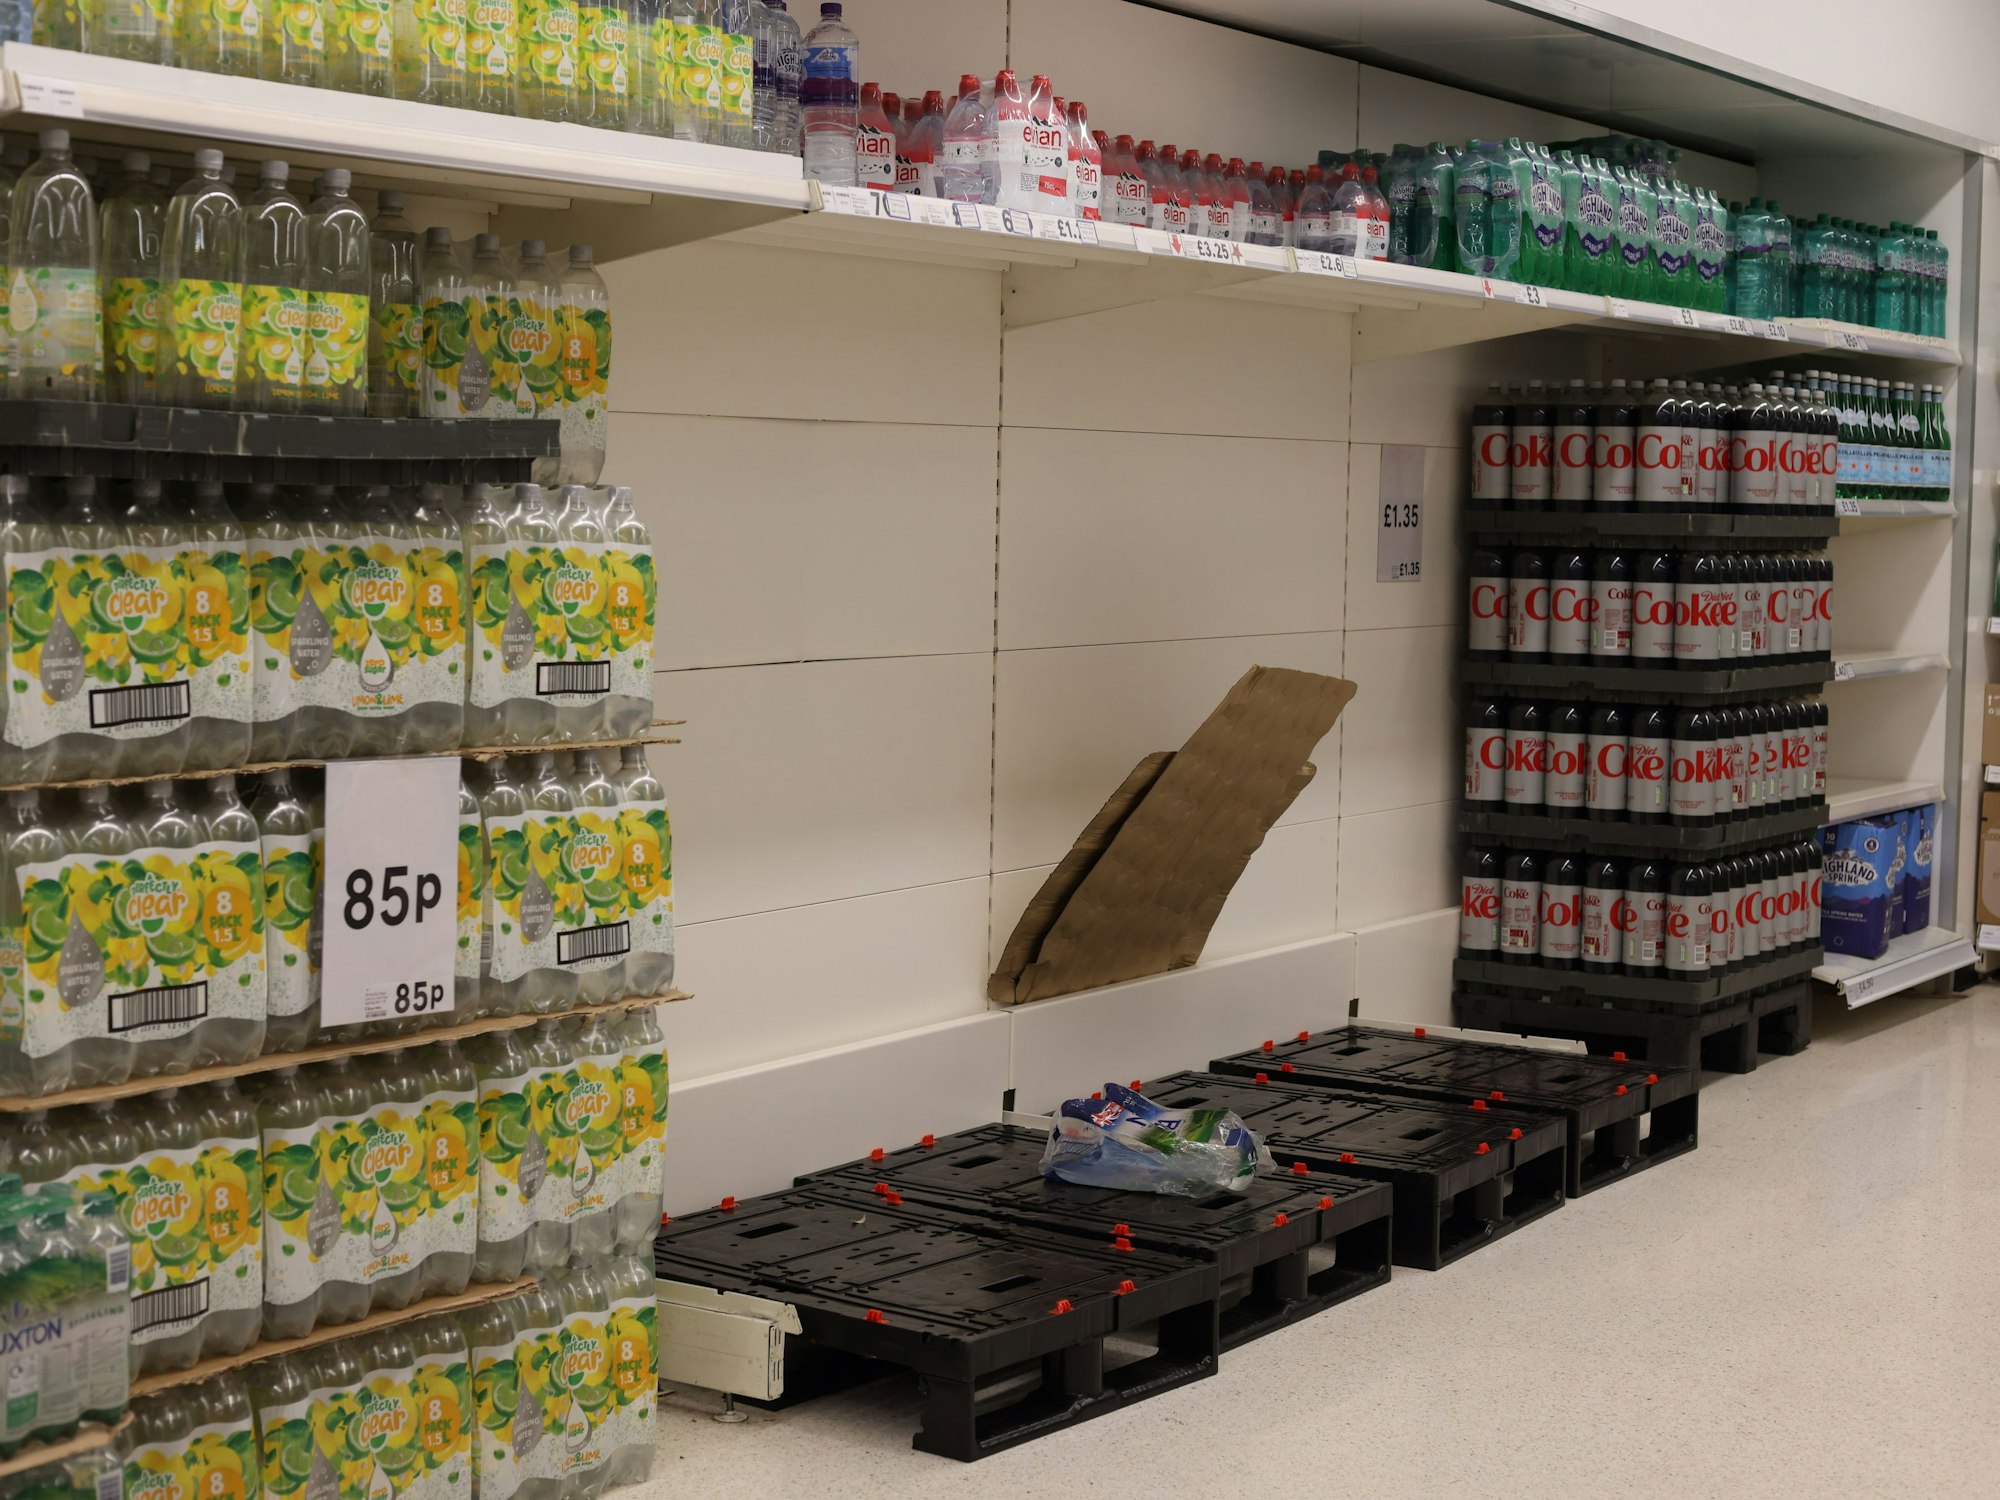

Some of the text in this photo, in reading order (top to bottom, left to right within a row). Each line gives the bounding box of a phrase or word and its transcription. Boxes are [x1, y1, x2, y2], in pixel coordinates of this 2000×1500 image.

[1197, 239, 1229, 259] £3.25
[1320, 255, 1343, 272] £2.6
[1526, 286, 1541, 304] £3
[1682, 308, 1694, 325] £3
[570, 339, 581, 358] 8
[565, 358, 590, 369] PACK
[1384, 504, 1419, 527] £1.35
[1399, 562, 1420, 576] £1.35
[196, 591, 209, 614] 8
[428, 584, 443, 606] 8
[617, 586, 629, 606] 8
[421, 606, 452, 618] PACK
[612, 606, 638, 617] PACK
[189, 614, 221, 628] PACK
[1826, 833, 1836, 841] 10
[632, 843, 645, 864] 8
[628, 863, 655, 876] PACK
[1828, 873, 1859, 884] SPRING
[343, 866, 442, 930] 85p
[1472, 884, 1496, 895] Diet
[1503, 886, 1529, 900] Coke
[217, 891, 232, 914] 8
[209, 914, 243, 928] PACK
[394, 981, 444, 1014] 85p
[625, 1087, 636, 1107] 8
[436, 1137, 448, 1159] 8
[431, 1157, 458, 1172] PACK
[215, 1188, 229, 1210] 8
[210, 1209, 240, 1223] PACK
[0, 1317, 62, 1356] UXTON
[621, 1341, 633, 1361] 8
[617, 1360, 643, 1372] PACK
[429, 1400, 442, 1420] 8
[424, 1418, 453, 1434] PACK
[211, 1472, 224, 1494] 8
